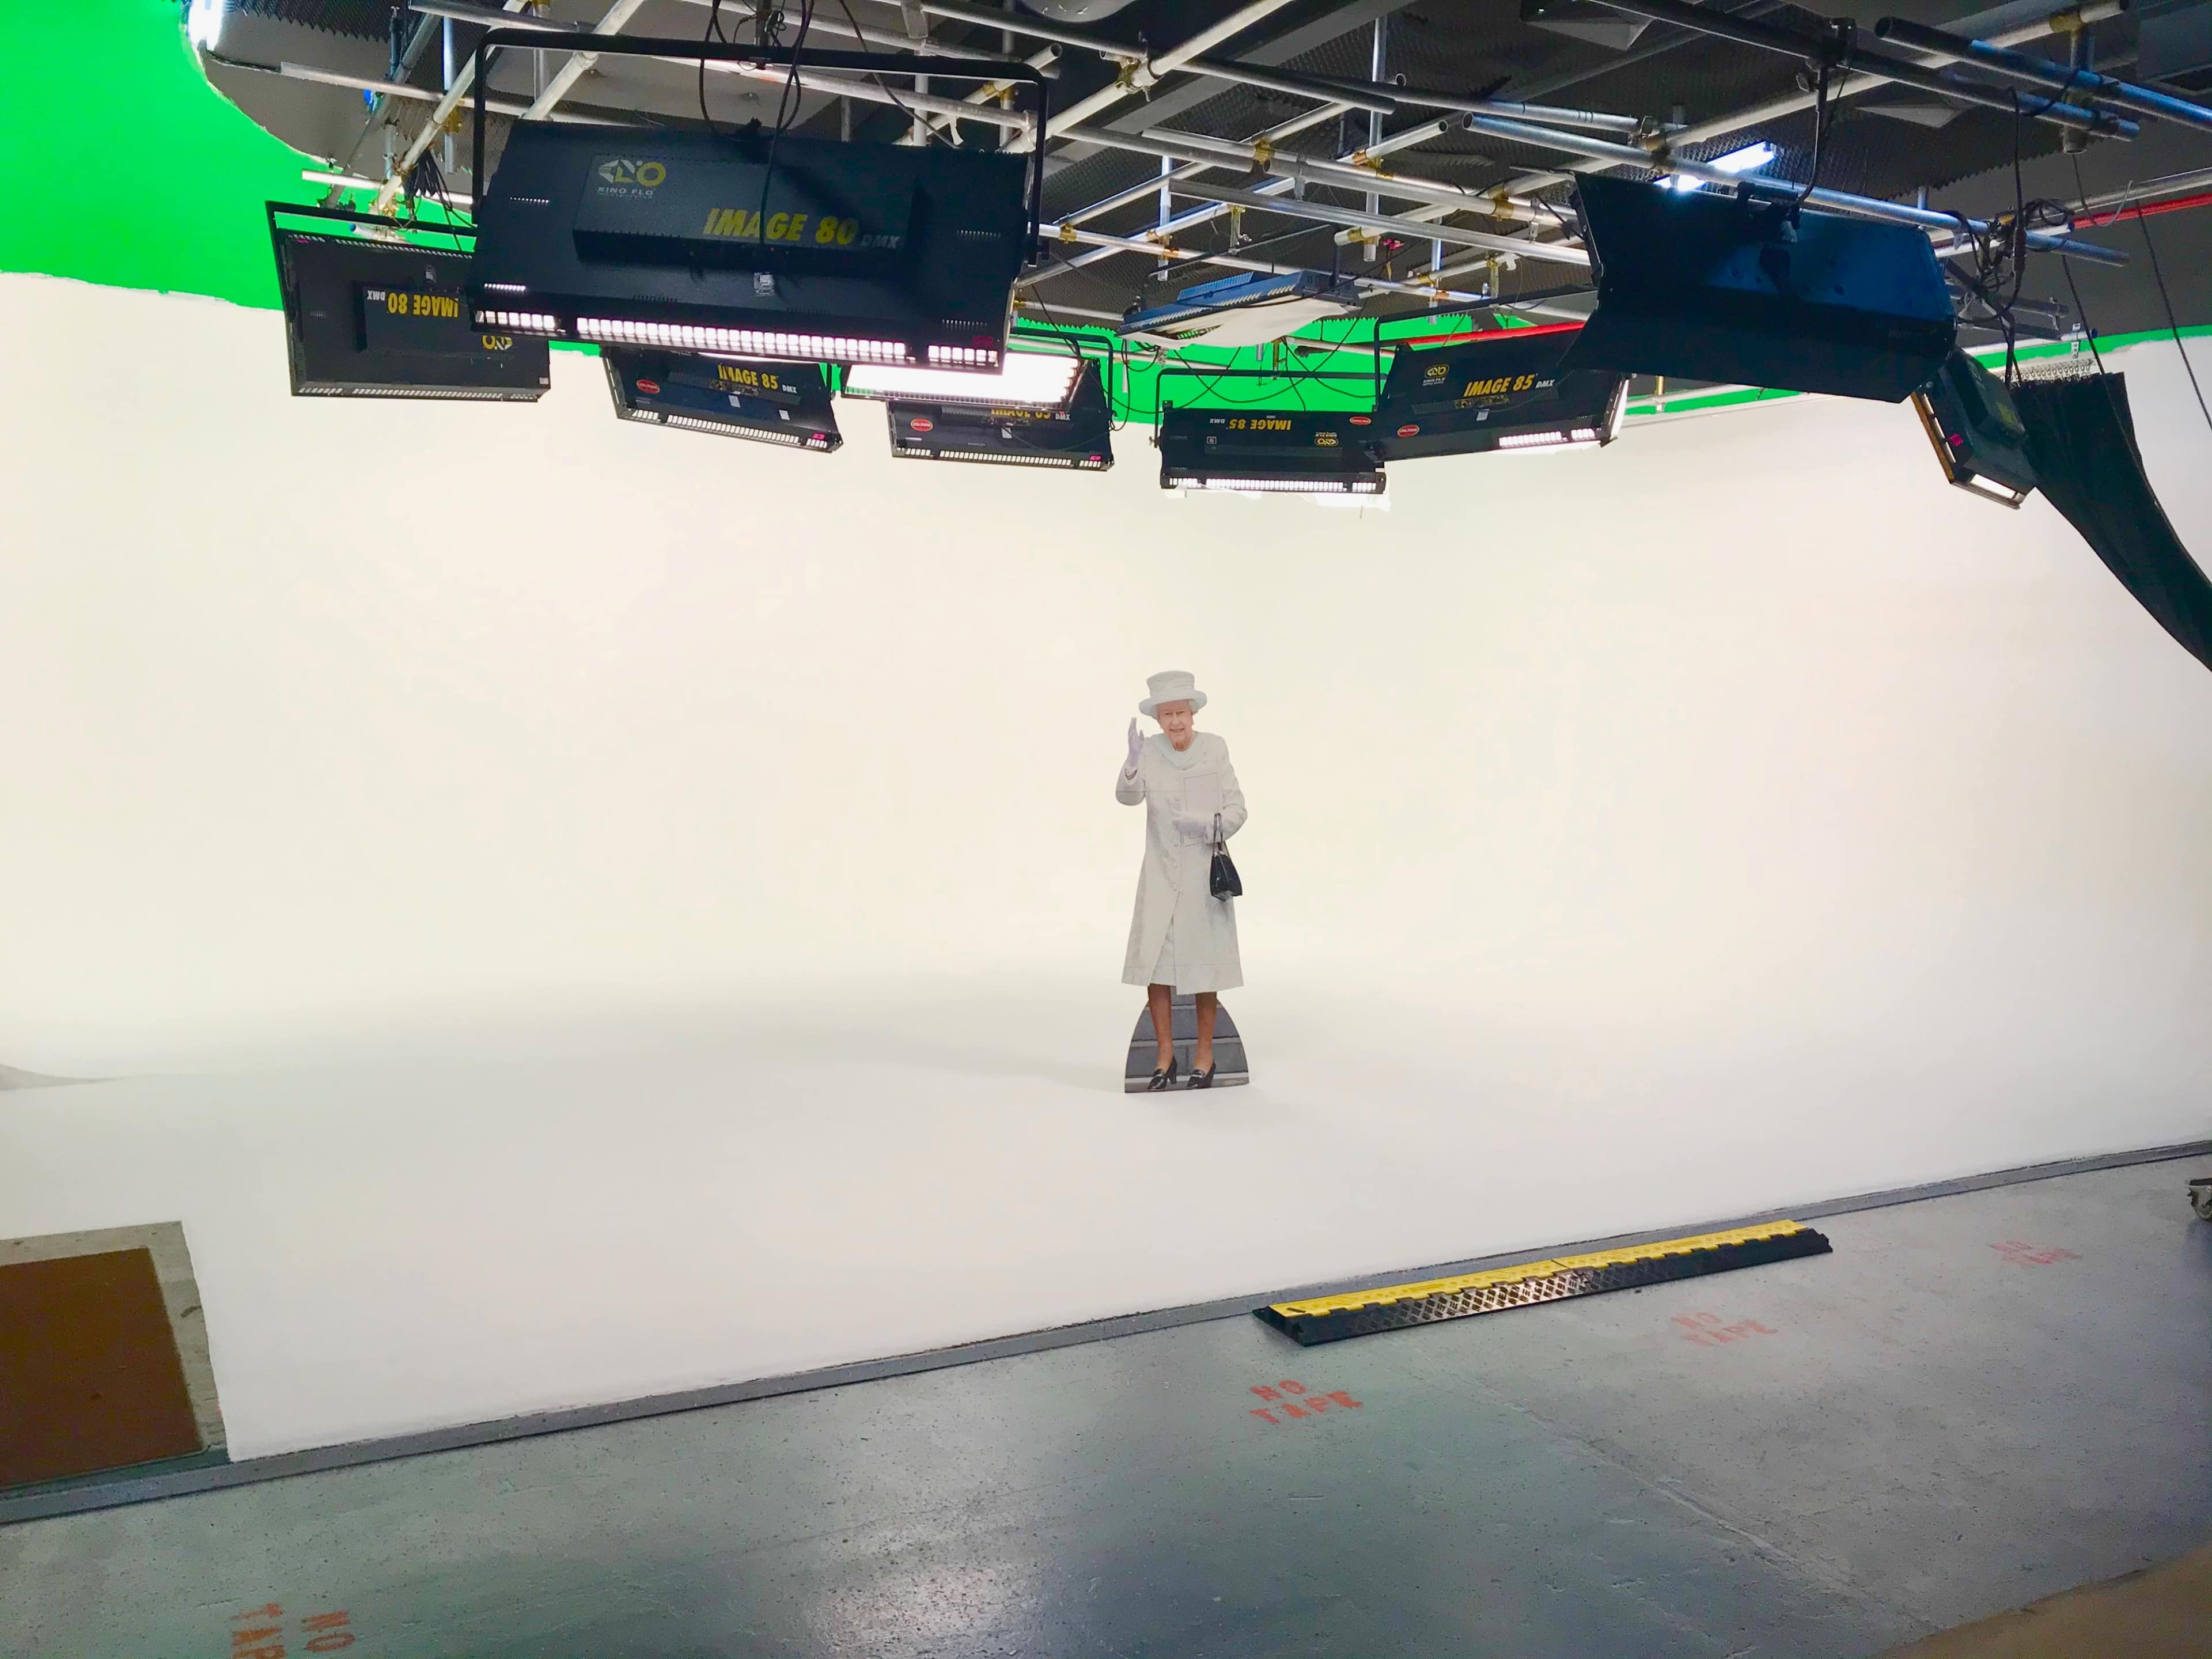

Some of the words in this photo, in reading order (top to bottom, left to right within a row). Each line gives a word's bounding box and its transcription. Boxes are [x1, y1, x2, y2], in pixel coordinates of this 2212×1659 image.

[598, 186, 627, 194] KINO
[702, 207, 808, 242] IMAGE
[815, 216, 859, 245] 80
[861, 234, 900, 249] DMX
[367, 290, 386, 301] DMX
[388, 293, 408, 315] 80
[412, 294, 459, 318] IMAGE
[718, 364, 759, 387] IMAGE
[761, 373, 778, 390] 85
[782, 384, 798, 393] DMX
[1463, 377, 1512, 397] IMAGE
[1513, 374, 1536, 391] 85
[1535, 379, 1555, 389] DMX
[1055, 413, 1071, 421] DMX
[1228, 418, 1247, 430] 85
[1249, 419, 1292, 431] IMAGE
[1249, 1380, 1307, 1402] NO
[1248, 1390, 1364, 1424] TAPE
[300, 1609, 357, 1653] NO
